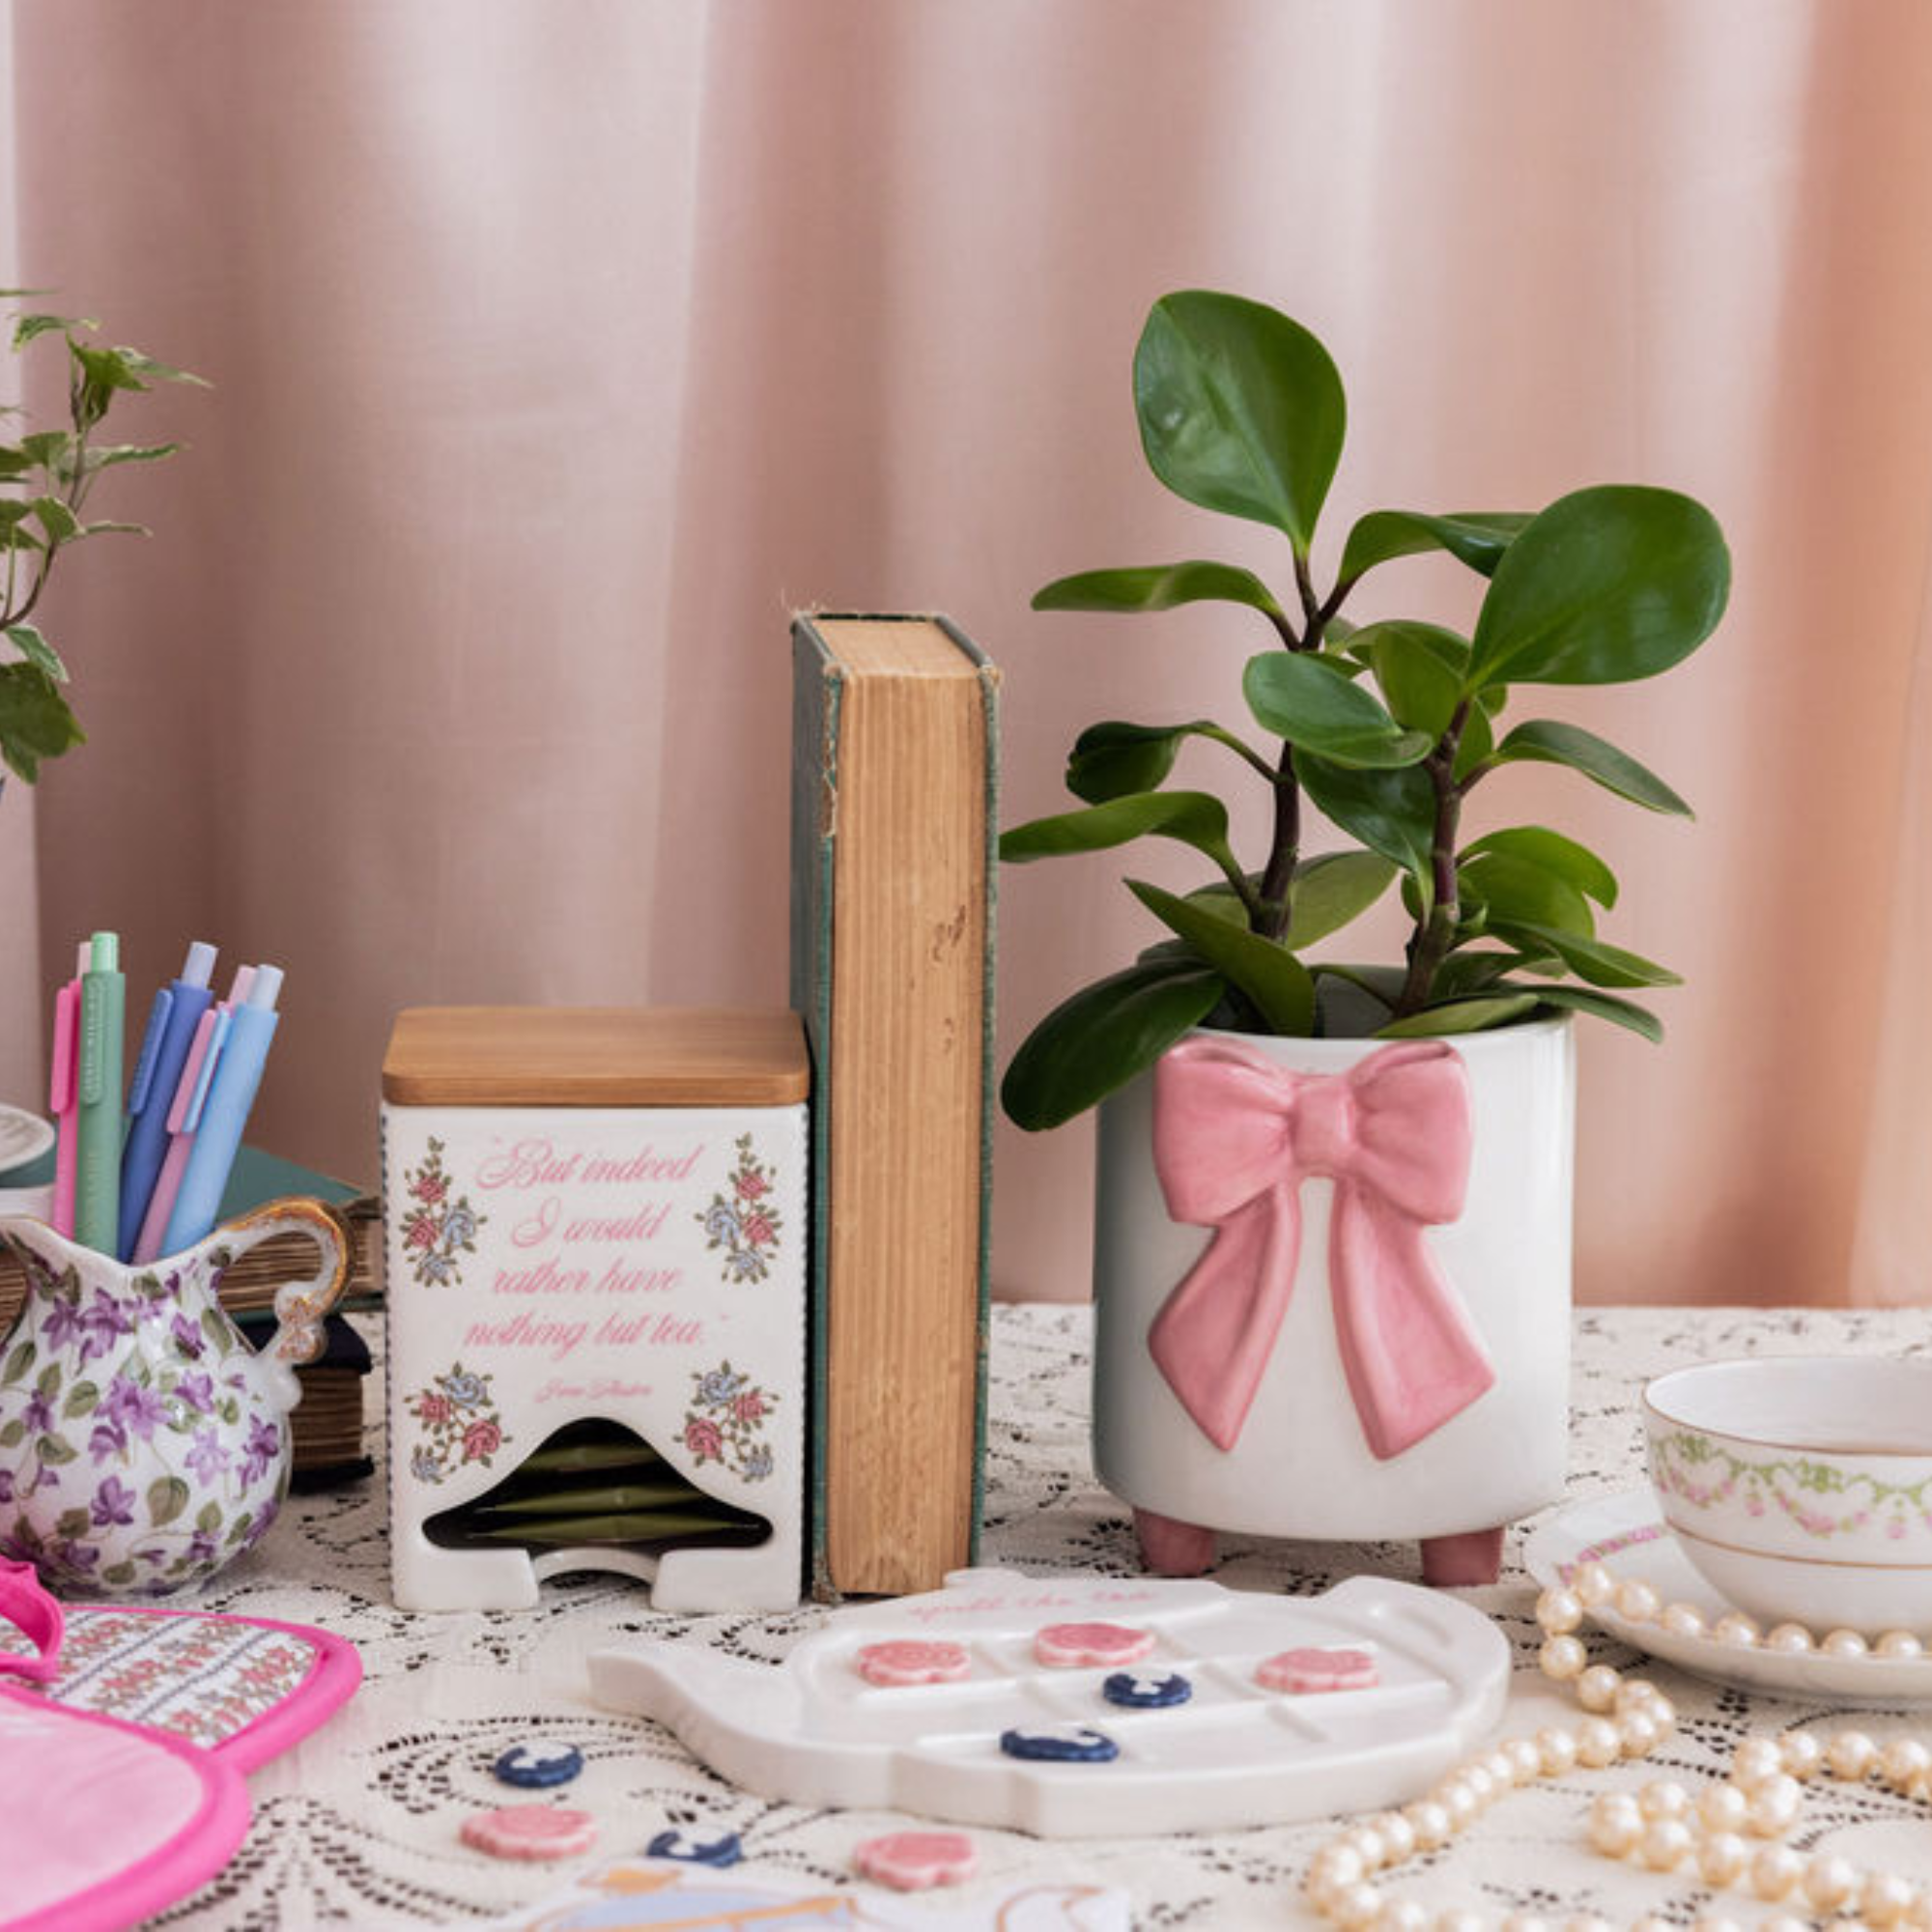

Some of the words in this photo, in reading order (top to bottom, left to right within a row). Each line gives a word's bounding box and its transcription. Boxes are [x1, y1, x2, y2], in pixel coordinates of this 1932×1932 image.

[580, 1143, 705, 1185] indeed
[510, 1197, 561, 1248] I
[563, 1202, 673, 1242] would
[493, 1257, 590, 1295] rather
[594, 1256, 685, 1294] have
[464, 1311, 588, 1361] nothing
[594, 1311, 647, 1347] but
